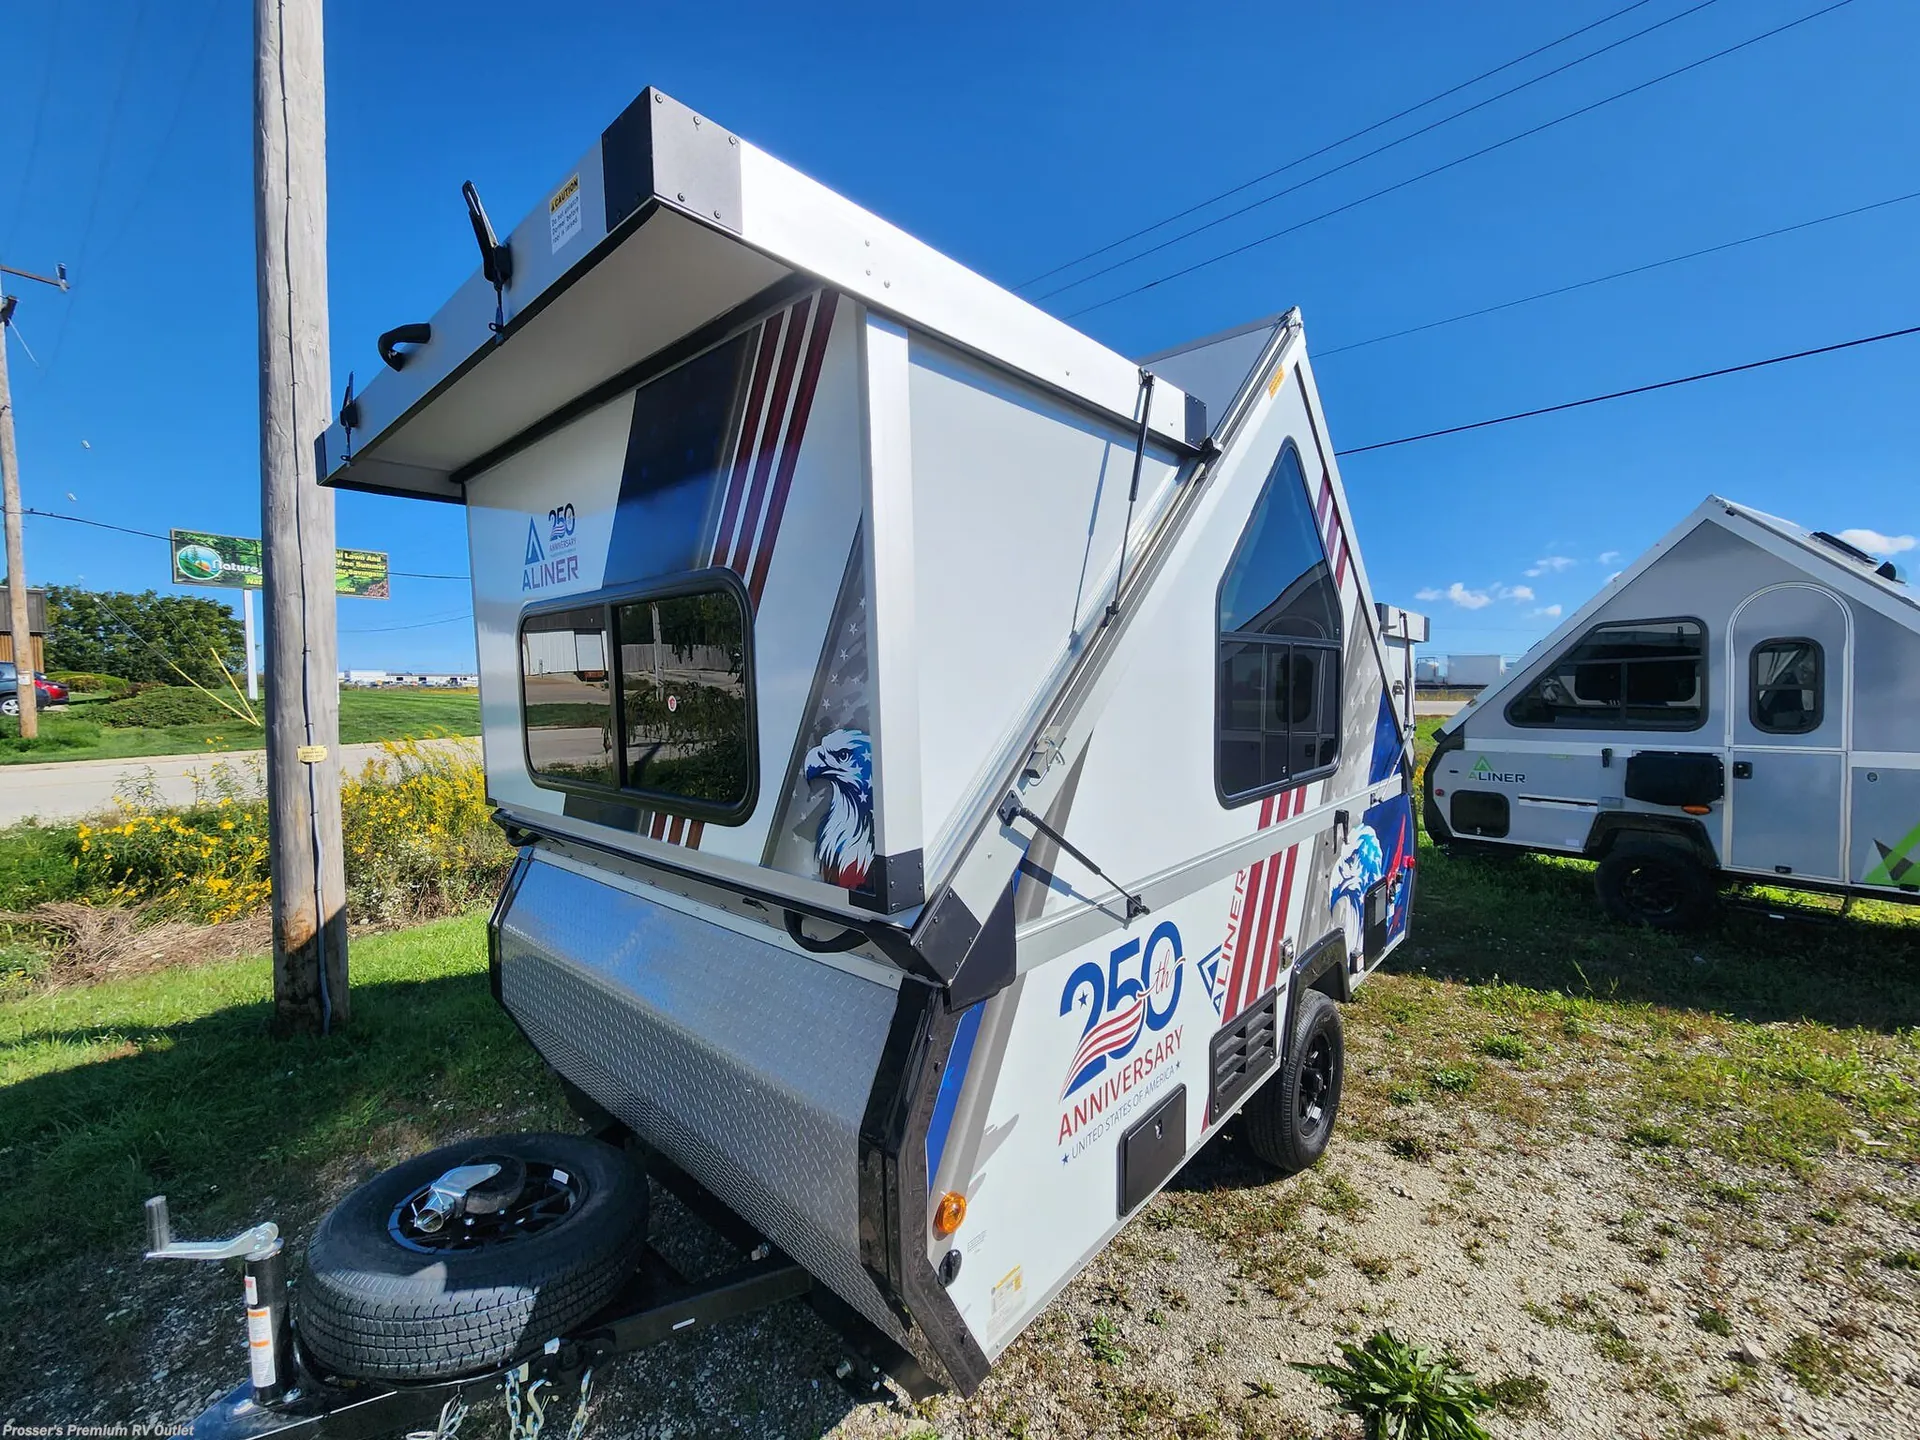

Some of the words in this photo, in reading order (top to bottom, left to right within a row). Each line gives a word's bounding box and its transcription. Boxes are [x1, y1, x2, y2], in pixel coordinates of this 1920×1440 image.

[554, 177, 579, 207] CAUTION
[344, 552, 366, 561] Lawn
[355, 561, 386, 570] Summer
[522, 555, 579, 591] ALINER
[1468, 771, 1526, 783] ALINER
[1212, 869, 1247, 1018] ALINER
[1058, 1024, 1184, 1147] ANNIVERSARY
[1071, 1123, 1104, 1159] UNITED
[1105, 1101, 1135, 1132] STATES
[1133, 1091, 1145, 1108] OF
[1144, 1065, 1175, 1099] AMERICA
